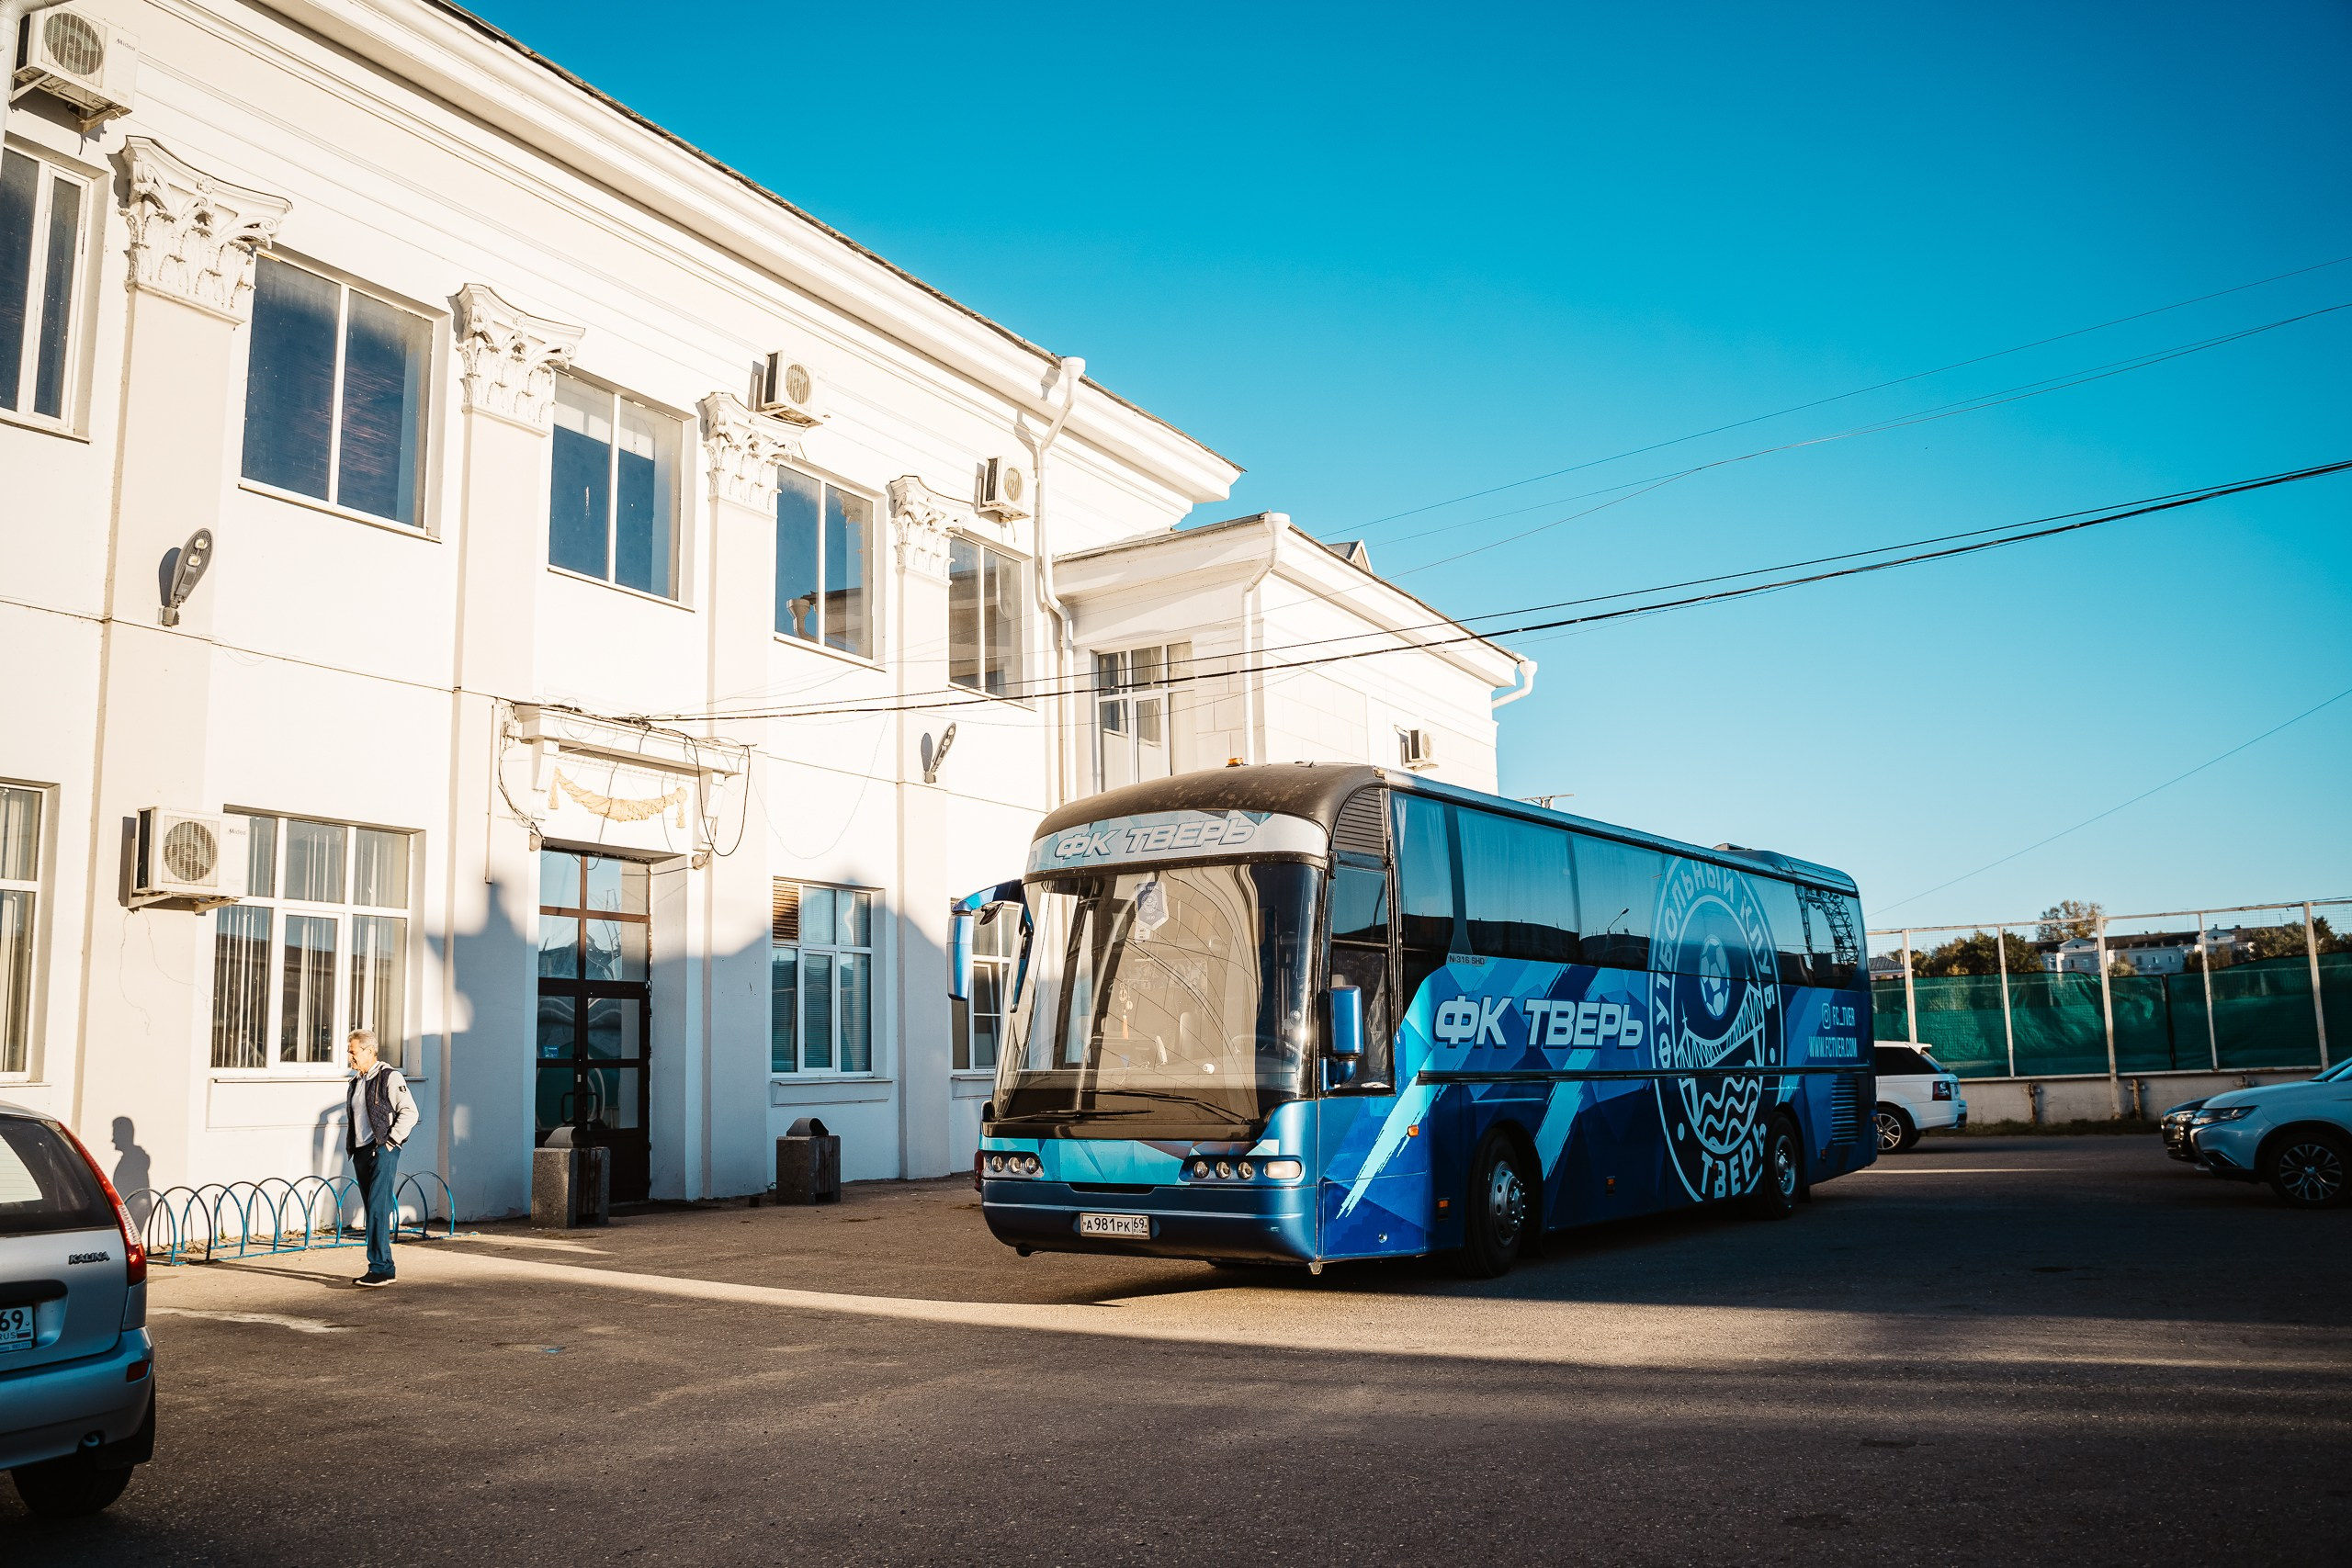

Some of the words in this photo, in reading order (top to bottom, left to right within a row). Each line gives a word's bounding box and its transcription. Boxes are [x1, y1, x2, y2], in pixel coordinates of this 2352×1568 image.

[1055, 829, 1121, 860] ФК
[1125, 818, 1256, 853] ТВЕРЬ
[1456, 955, 1470, 964] 316
[1471, 956, 1485, 965] SHD
[1434, 995, 1514, 1047] ФК
[1523, 998, 1645, 1049] ТВЕРЬ
[1832, 1005, 1856, 1027] FC_TVER
[1808, 1035, 1858, 1058] WWW.FCTVER.COM
[1701, 1122, 1767, 1199] ТВЕРЬ
[68, 1250, 110, 1265] KALINA
[0, 1309, 24, 1332] 69
